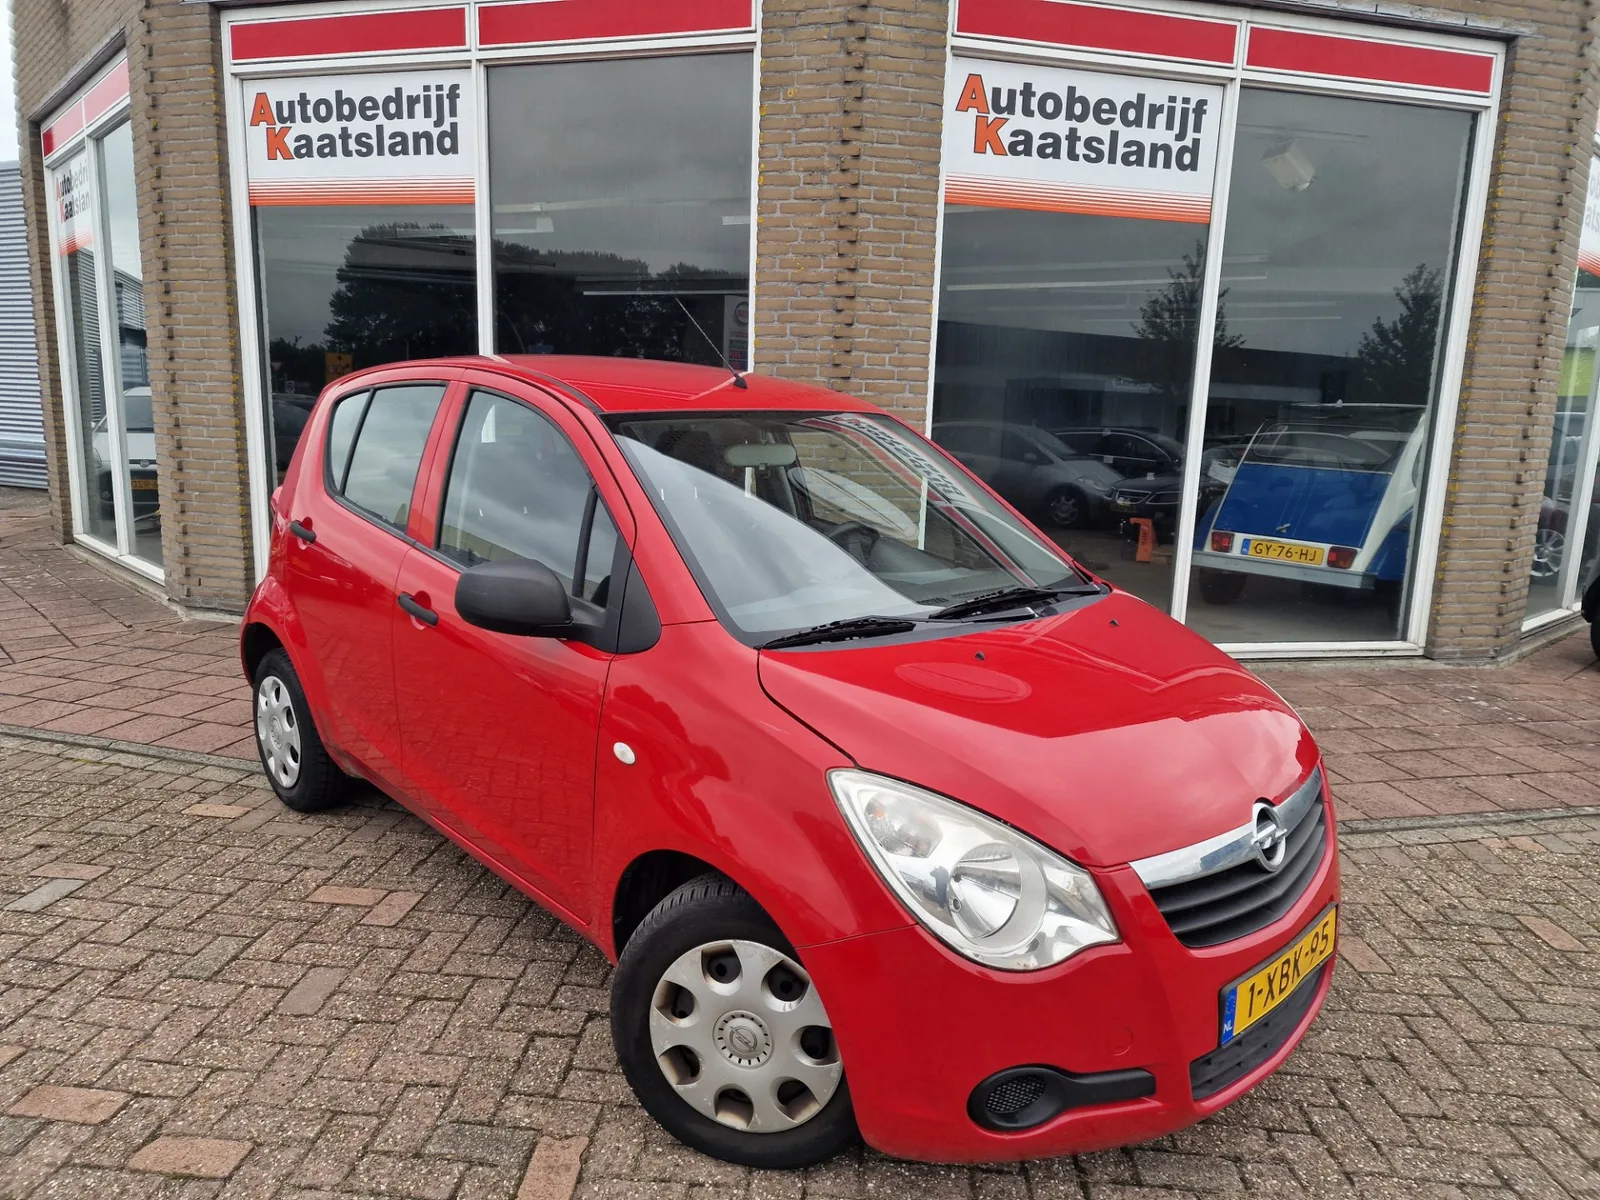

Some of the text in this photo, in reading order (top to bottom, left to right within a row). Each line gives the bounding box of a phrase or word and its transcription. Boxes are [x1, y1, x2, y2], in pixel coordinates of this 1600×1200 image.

[250, 83, 461, 128] Autobedrijf
[955, 73, 1208, 142] Autobedrijf
[265, 121, 459, 160] Kaatsland
[973, 114, 1201, 172] Kaatsland
[59, 191, 90, 224] Kaatslan
[1254, 542, 1317, 562] GY-76-HJ
[1247, 919, 1330, 1019] 1-XBK-95
[1223, 1020, 1233, 1034] NL
